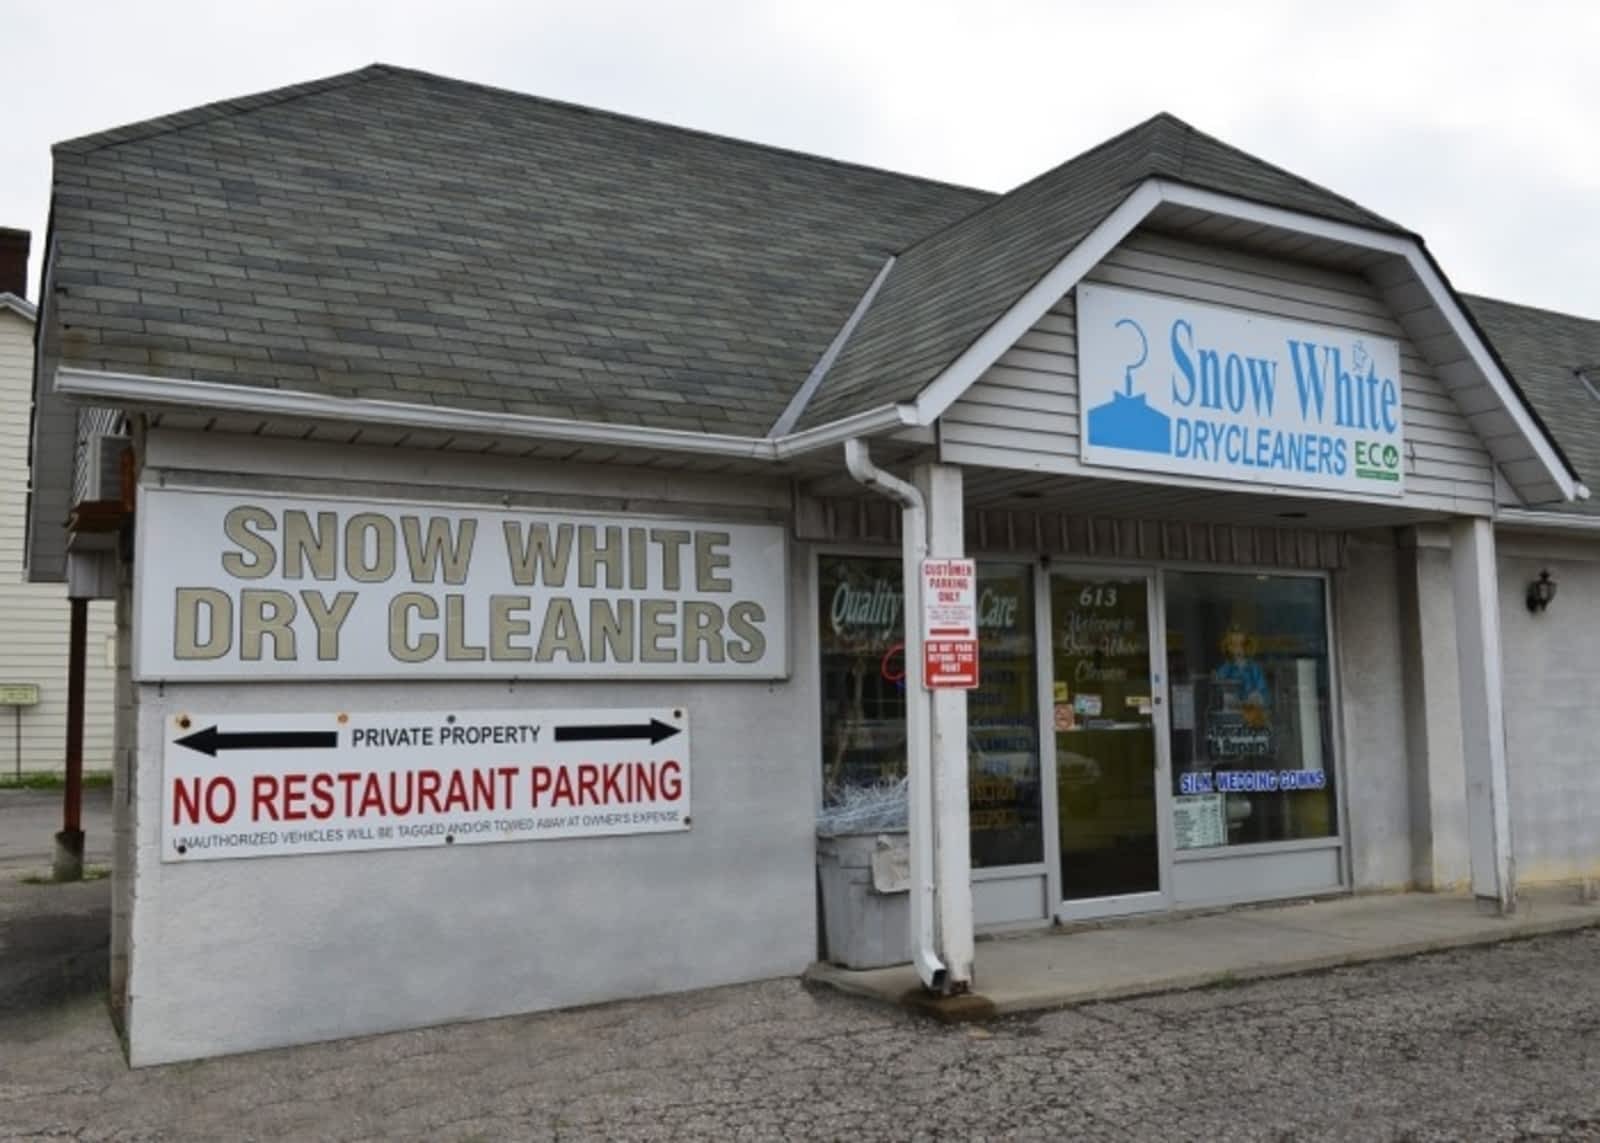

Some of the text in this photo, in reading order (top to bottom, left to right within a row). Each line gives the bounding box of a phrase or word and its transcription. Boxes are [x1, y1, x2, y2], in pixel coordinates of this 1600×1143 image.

[1171, 319, 1398, 434] Snow White
[1175, 417, 1347, 476] DRYCLEANERS
[1355, 440, 1398, 469] ECO
[221, 505, 733, 593] SNOW WHITE
[930, 578, 968, 590] PARKING
[938, 591, 960, 602] ONLY
[1080, 586, 1117, 606] 613
[173, 586, 767, 664] DRY CLEANERS
[831, 581, 904, 640] Quality
[977, 588, 1016, 627] Care
[351, 724, 541, 748] PRIVATE PROPERTY
[172, 760, 682, 825] NO RESTAURANT PARKING
[1181, 768, 1326, 794] SILK WEDDING GOWNS
[173, 830, 278, 850] UNAUTHORIZED
[281, 827, 343, 844] VEHICLES
[347, 825, 373, 840] WILL
[377, 824, 394, 839] BE
[398, 821, 444, 837] TAGGED
[448, 818, 492, 834] AND/OR
[494, 817, 533, 832] TOWED
[536, 815, 566, 830] AWAY
[567, 814, 580, 827] AT
[632, 810, 680, 824] EXPENSE
